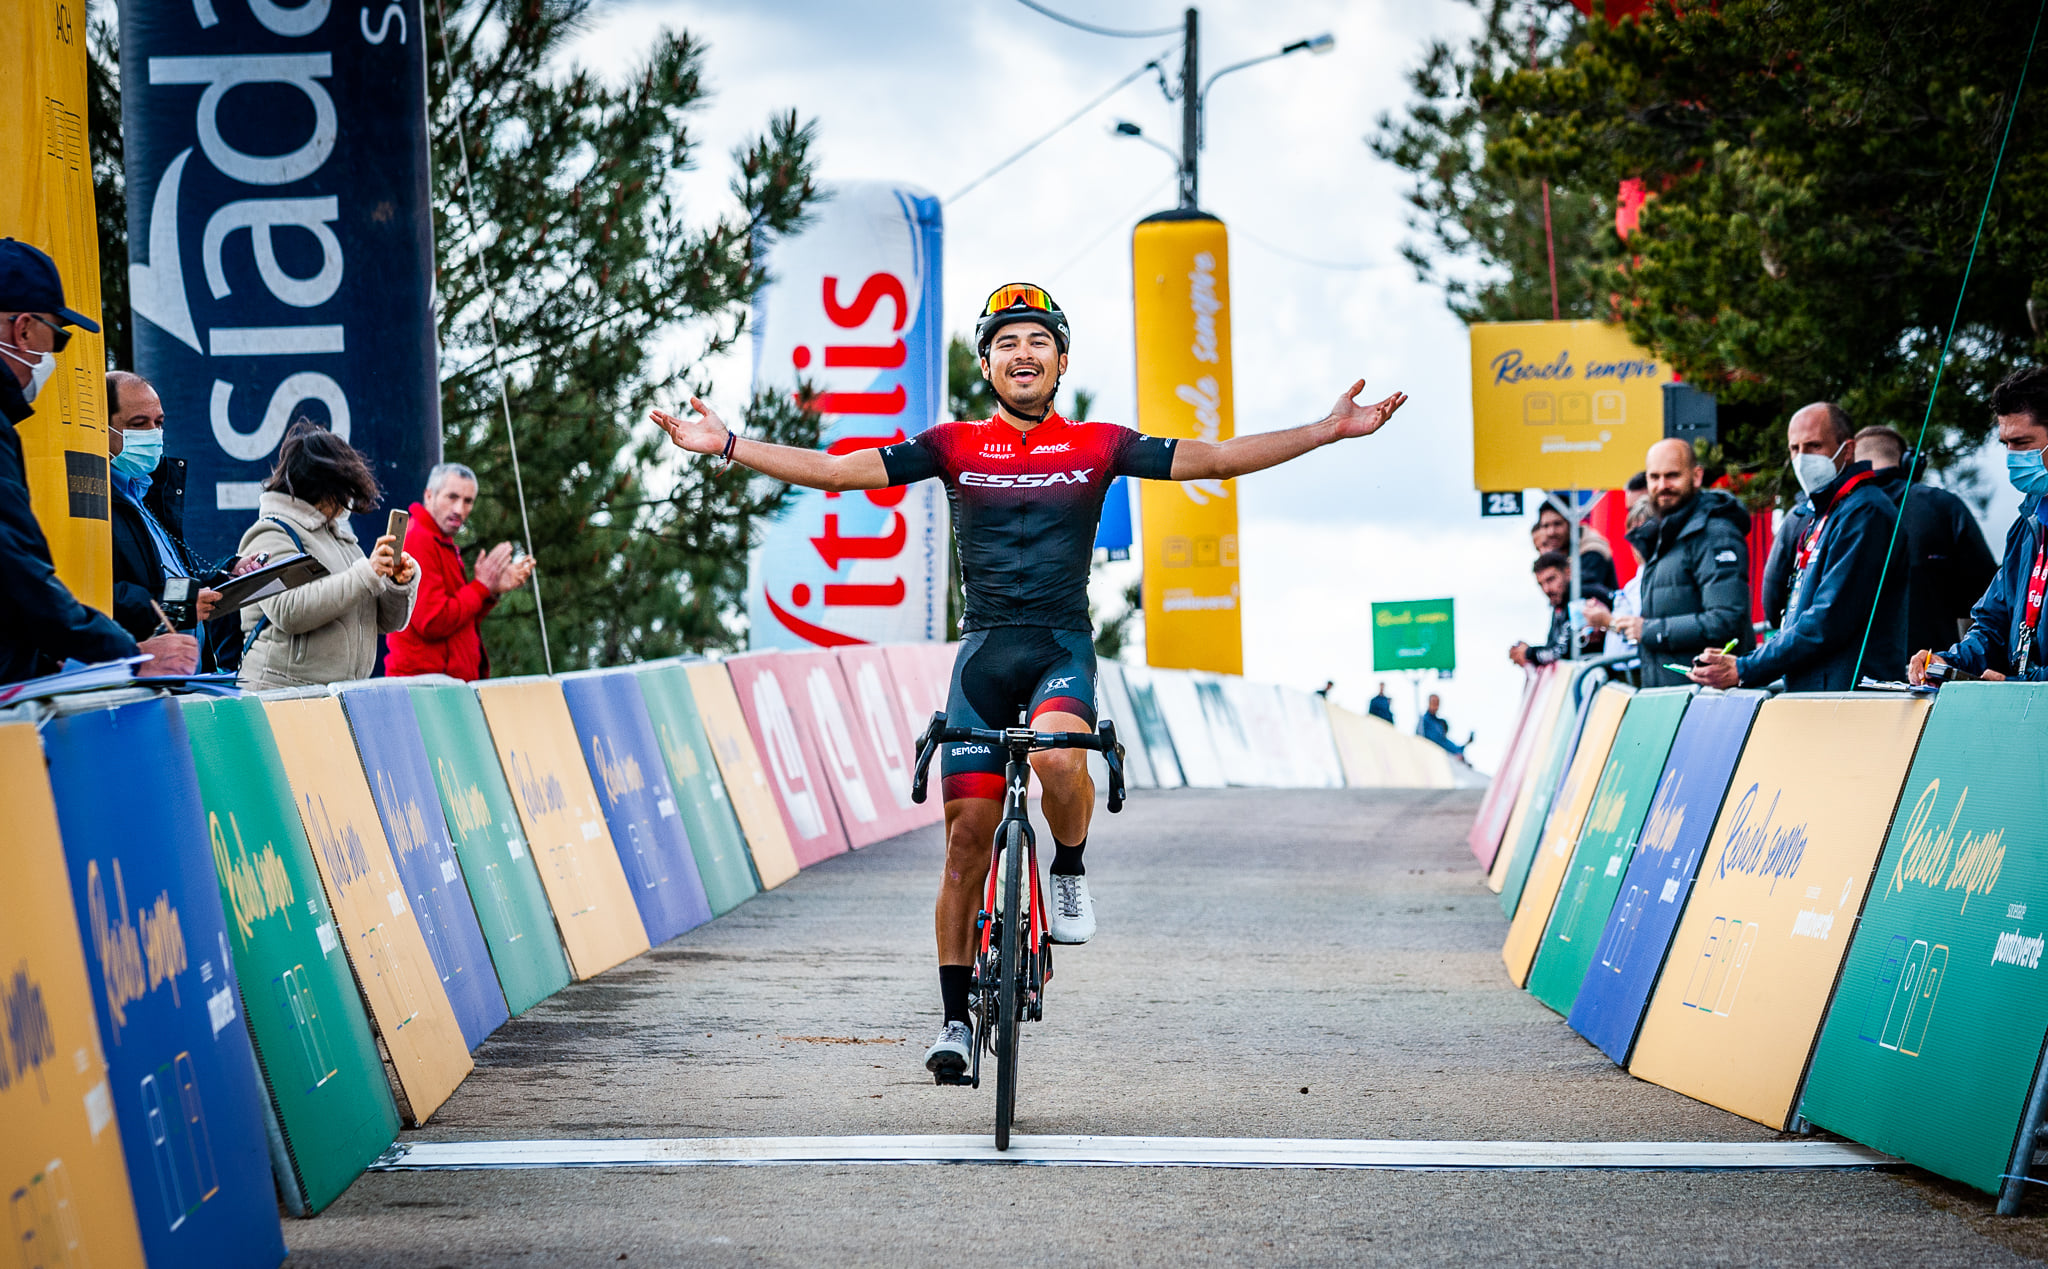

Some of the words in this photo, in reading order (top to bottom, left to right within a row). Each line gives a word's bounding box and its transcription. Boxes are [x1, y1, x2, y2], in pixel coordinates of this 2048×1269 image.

[1584, 359, 1658, 384] sempre
[958, 468, 1095, 488] ESSAX
[951, 745, 991, 757] SEMOSA
[1709, 782, 1782, 889] Recicle
[1758, 822, 1808, 897] sempre
[1883, 778, 1969, 903] Recicle
[1944, 827, 2006, 916] sempre
[1990, 927, 2045, 970] pontoverde
